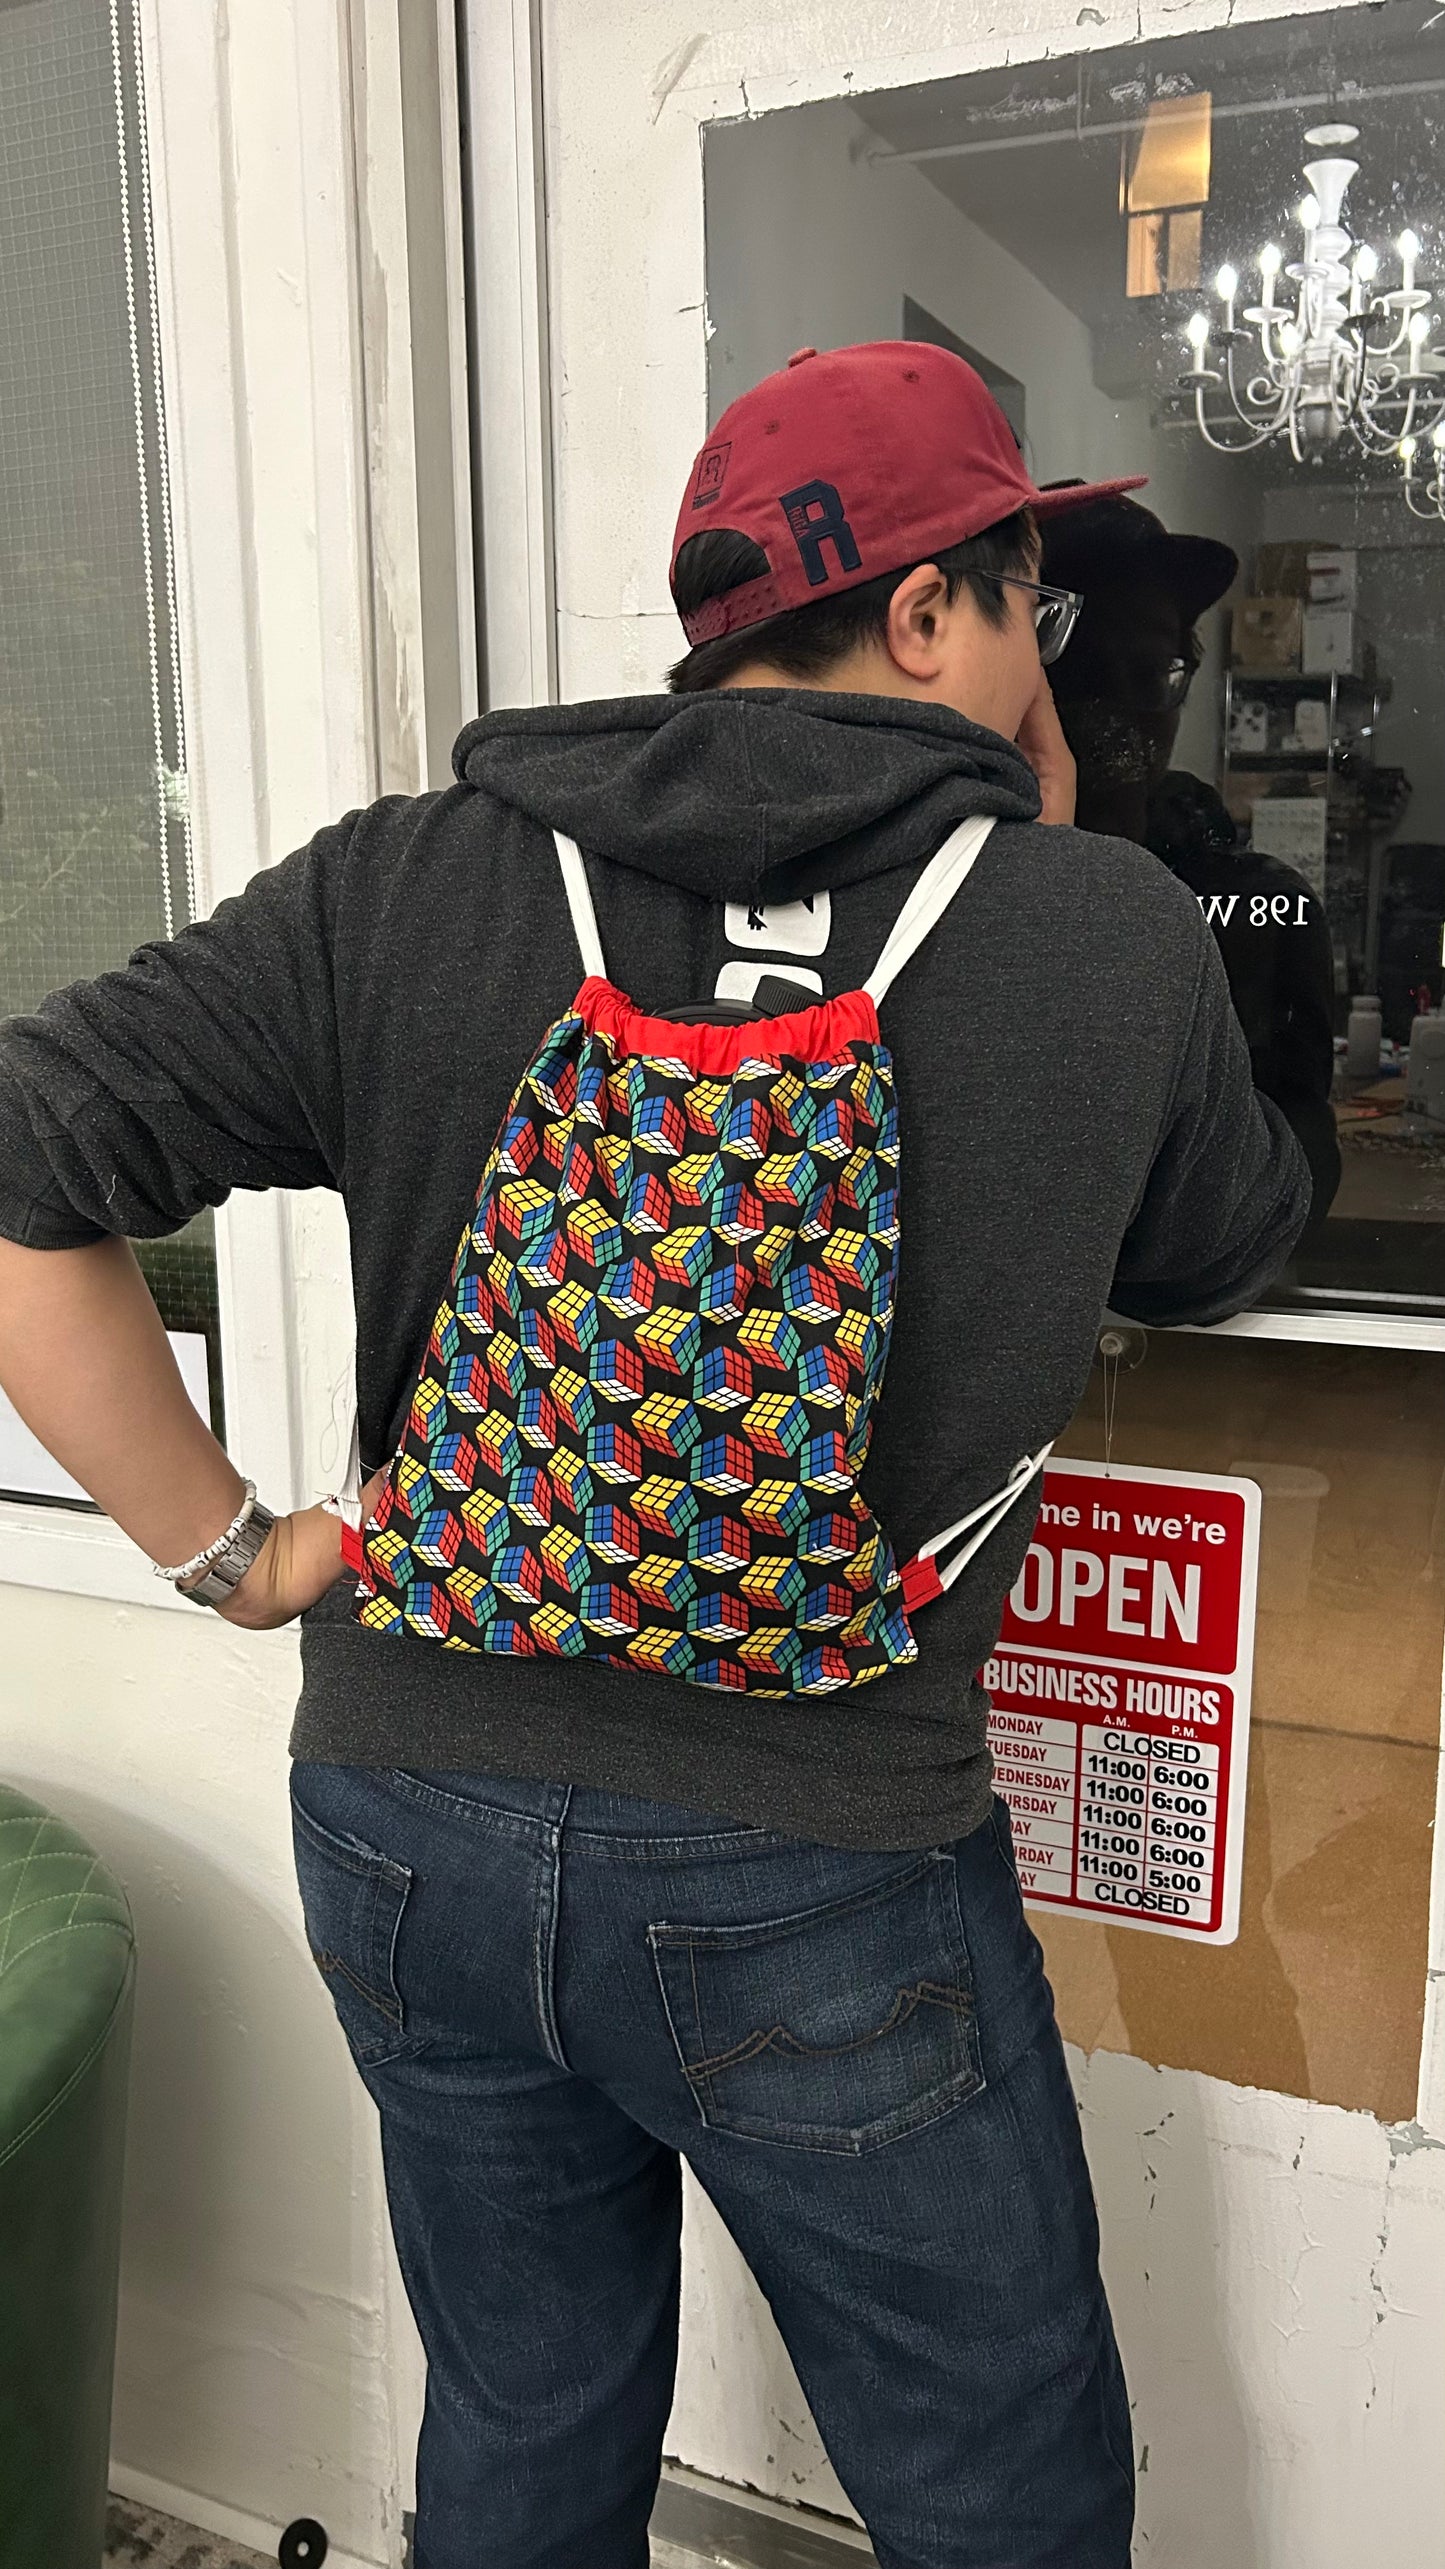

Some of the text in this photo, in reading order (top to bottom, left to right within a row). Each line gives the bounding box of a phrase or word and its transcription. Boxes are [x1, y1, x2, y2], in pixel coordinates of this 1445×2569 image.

[778, 478, 863, 587] R
[1040, 1502, 1227, 1546] me in we're
[1009, 1542, 1201, 1645] OPEN
[983, 1657, 1221, 1726] BUSINESS HOURS
[987, 1714, 1201, 1764] MONDAY CLOSED
[1102, 1714, 1199, 1739] A.M. P.M.
[1088, 1754, 1146, 1781] 11:00
[1153, 1766, 1210, 1791] 6:00
[1086, 1780, 1145, 1805] 11:00
[1151, 1791, 1207, 1817] 6:00
[1083, 1804, 1142, 1830] 11:00
[1151, 1817, 1206, 1843] 6:00
[1080, 1830, 1205, 1868] 11:00 6:00
[1079, 1855, 1138, 1881] 11:00
[1148, 1870, 1201, 1893] 5:00
[1094, 1882, 1190, 1916] CLOSED
